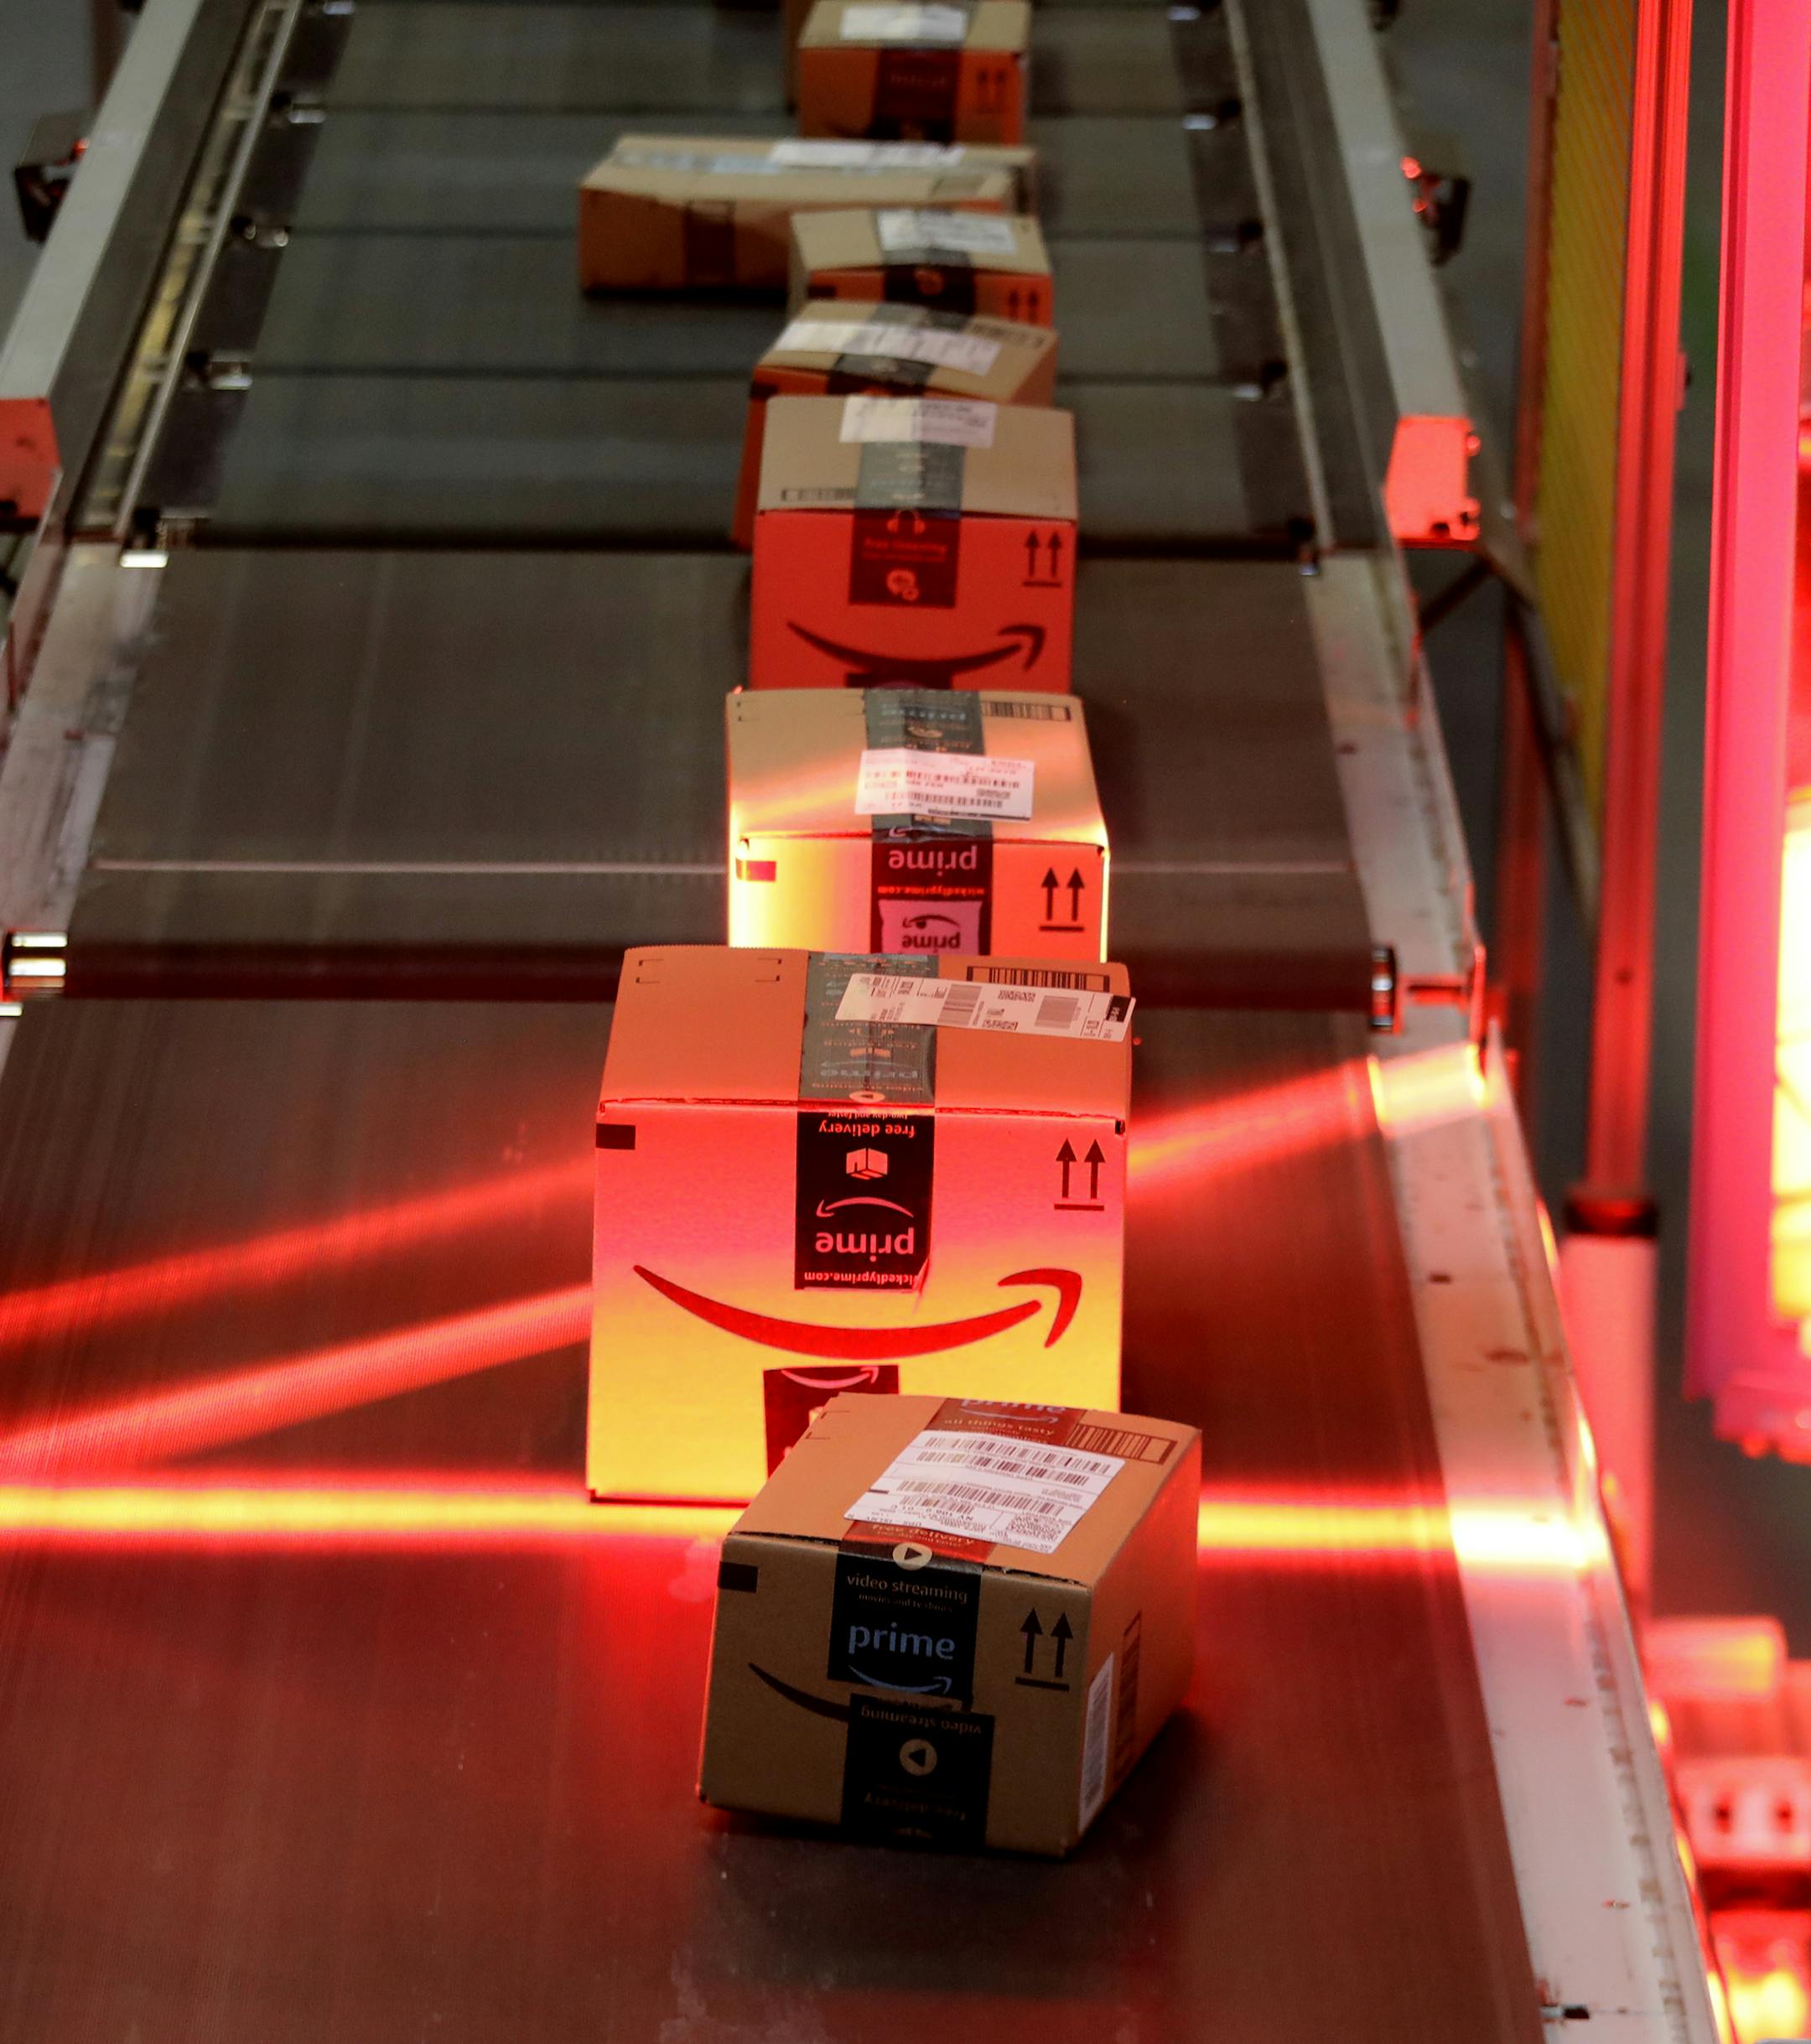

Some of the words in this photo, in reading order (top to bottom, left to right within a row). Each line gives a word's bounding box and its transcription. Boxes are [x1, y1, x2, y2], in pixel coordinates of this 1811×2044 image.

[888, 844, 978, 877] prime
[877, 885, 984, 897] wickedlyprime.com
[901, 931, 960, 953] prime
[828, 1112, 853, 1120] faster
[854, 1112, 870, 1120] and
[818, 1120, 880, 1137] delivery
[885, 1124, 916, 1139] free
[814, 1227, 915, 1262] prime
[805, 1271, 919, 1286] ickedlyprime.com
[871, 1523, 905, 1533] free
[908, 1527, 976, 1545] delivery
[846, 1572, 888, 1590] video
[891, 1580, 968, 1604] streaming
[859, 1594, 891, 1604] movies
[894, 1599, 911, 1607] and
[848, 1621, 956, 1661] prime
[860, 1704, 937, 1729] streaming
[941, 1720, 982, 1736] video
